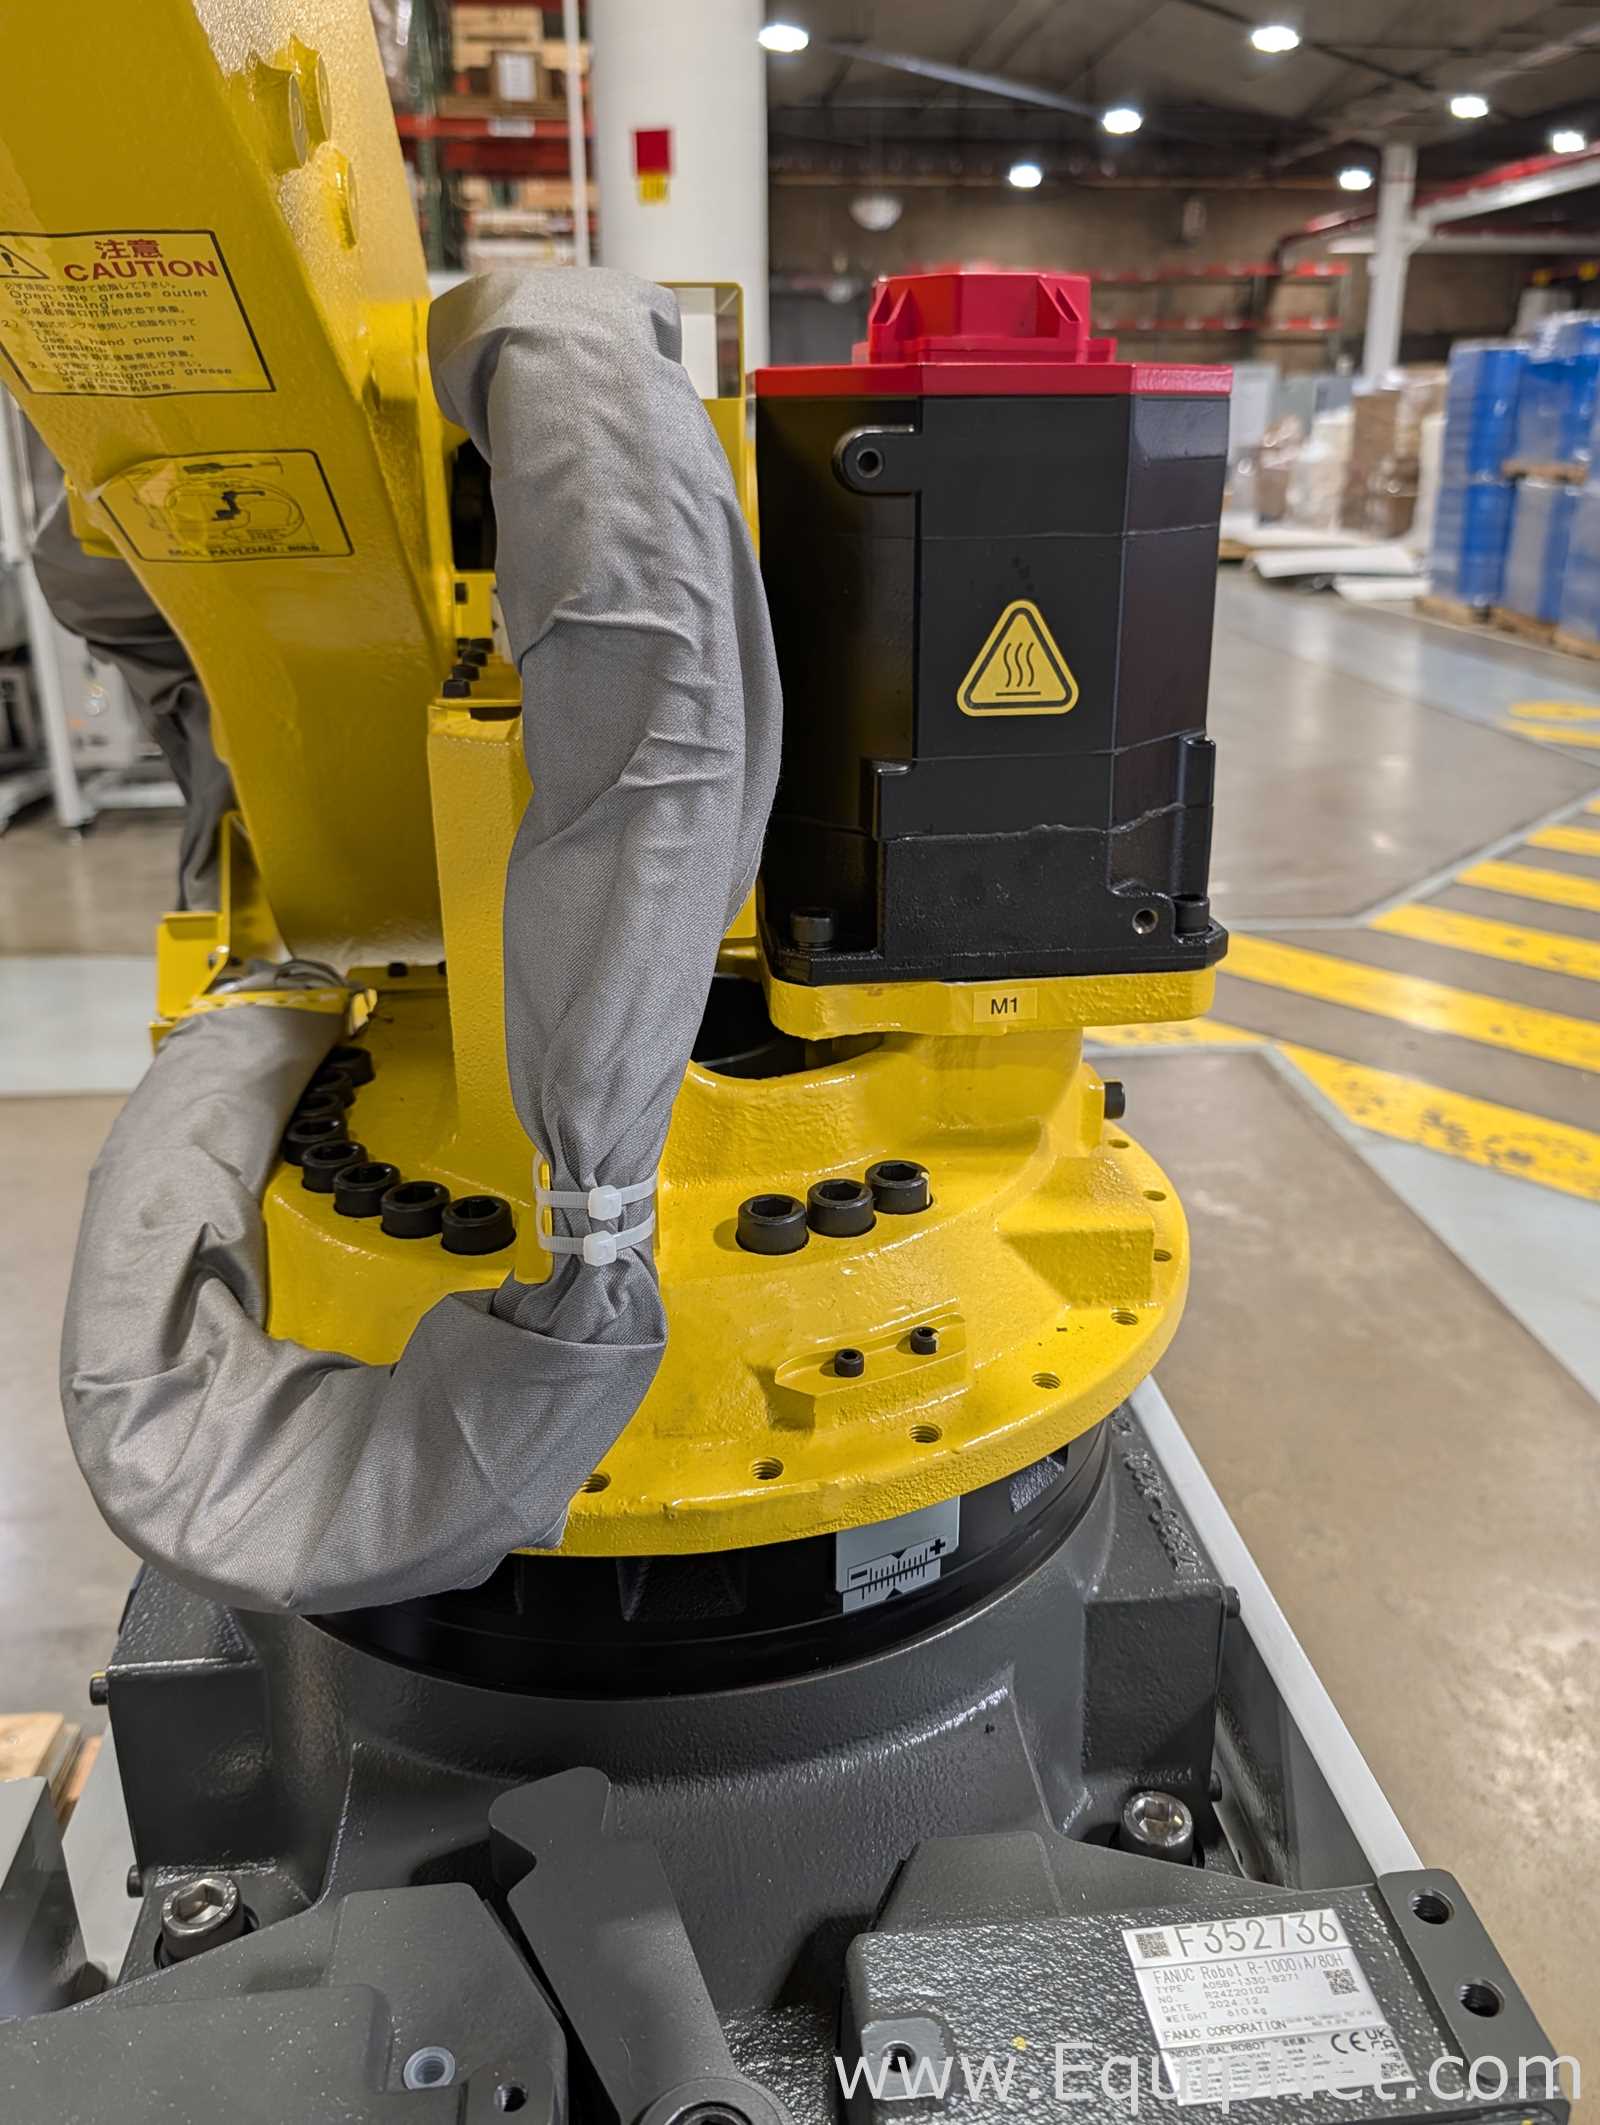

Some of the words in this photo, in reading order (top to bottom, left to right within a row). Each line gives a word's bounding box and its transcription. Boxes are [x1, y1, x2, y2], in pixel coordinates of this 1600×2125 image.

[94, 239, 163, 260] 注意
[64, 260, 220, 282] CAUTION
[10, 290, 53, 300] Open
[62, 293, 88, 302] the
[99, 291, 151, 302] grease
[163, 289, 208, 298] outlet
[88, 337, 125, 346] hand
[134, 336, 175, 346] pump
[184, 368, 232, 376] grease
[991, 997, 1018, 1015] M1
[1173, 1912, 1339, 1958] F352736
[1153, 1967, 1196, 1985] FANUC
[1200, 1962, 1245, 1981] Robot
[1156, 1984, 1185, 1994] TYPE
[1161, 2003, 1192, 2014] DATE
[1165, 2012, 1209, 2023] WEIGHT
[1252, 2007, 1268, 2016] kg
[1163, 2028, 1202, 2041] FANUC
[1207, 2020, 1288, 2037] CORPORATION
[1330, 2031, 1367, 2055] CE
